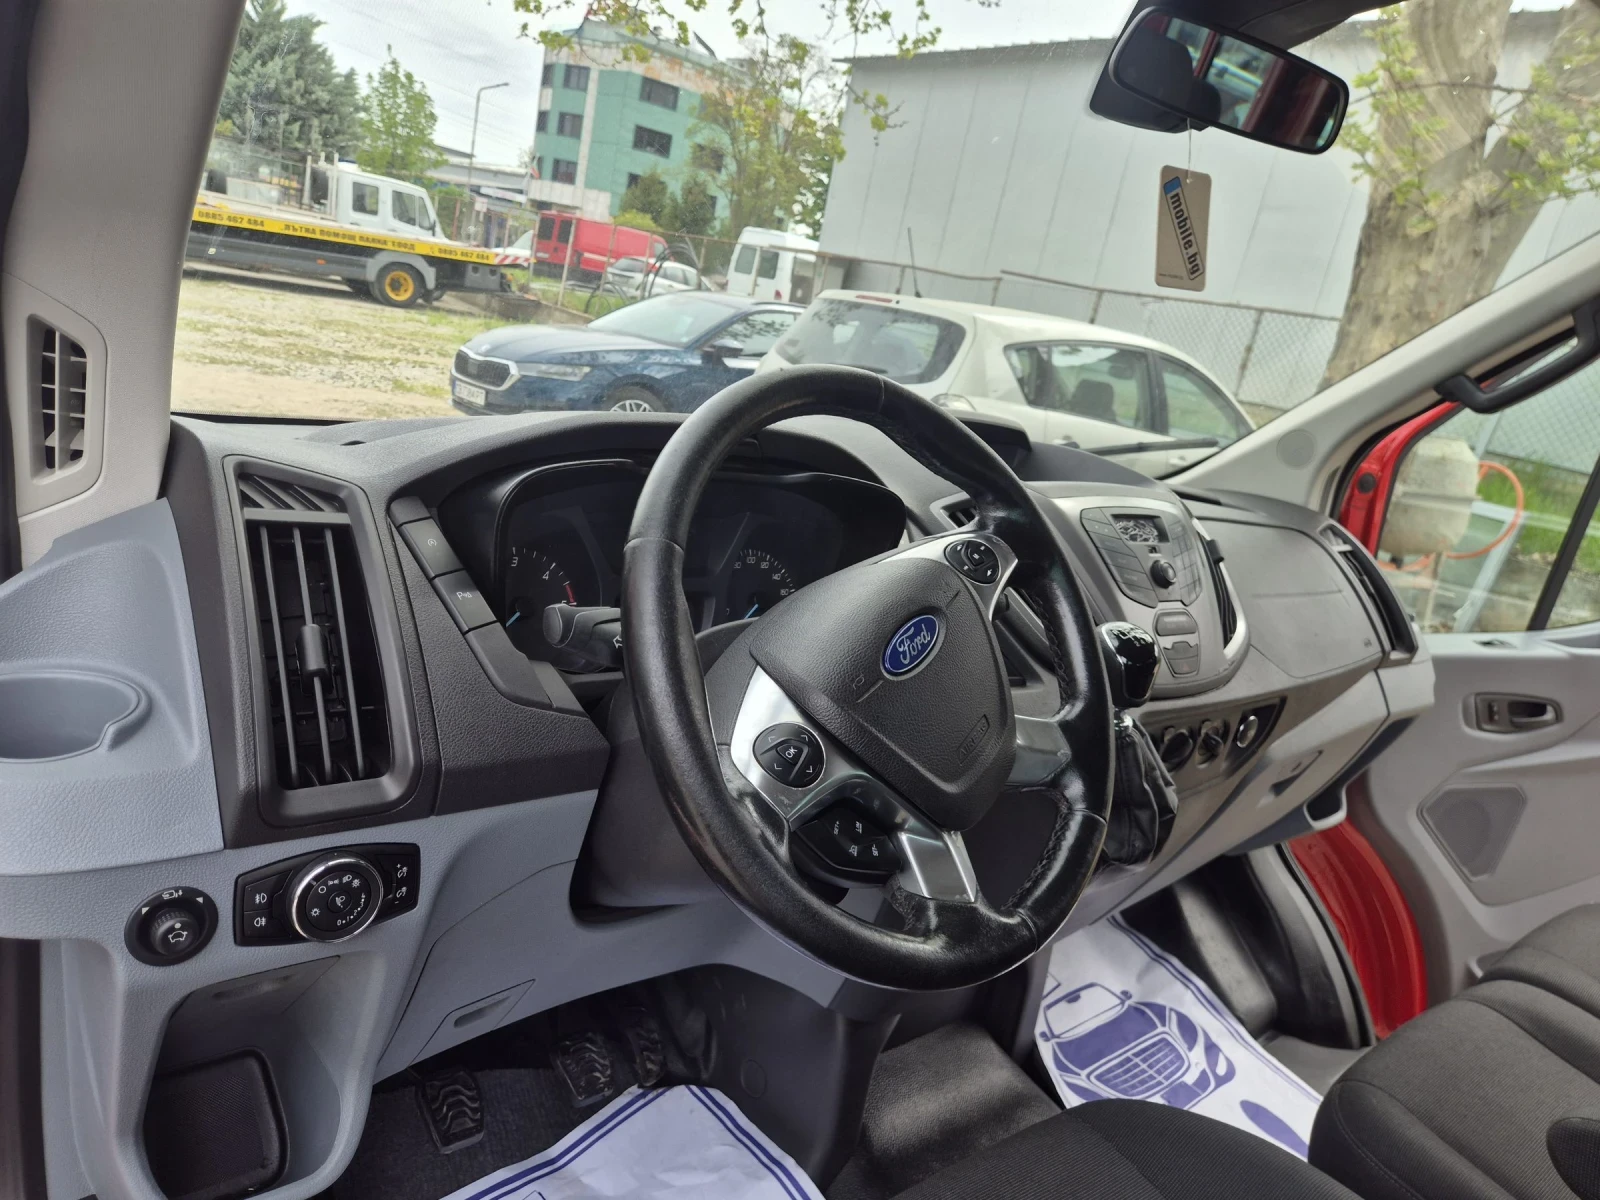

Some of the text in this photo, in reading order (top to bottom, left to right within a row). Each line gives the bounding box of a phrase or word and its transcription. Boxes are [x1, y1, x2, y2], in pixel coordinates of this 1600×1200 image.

[1170, 192, 1200, 275] mobile.bg
[511, 556, 519, 567] 3
[542, 570, 550, 580] 4
[896, 623, 931, 665] Ford
[785, 745, 798, 758] OK
